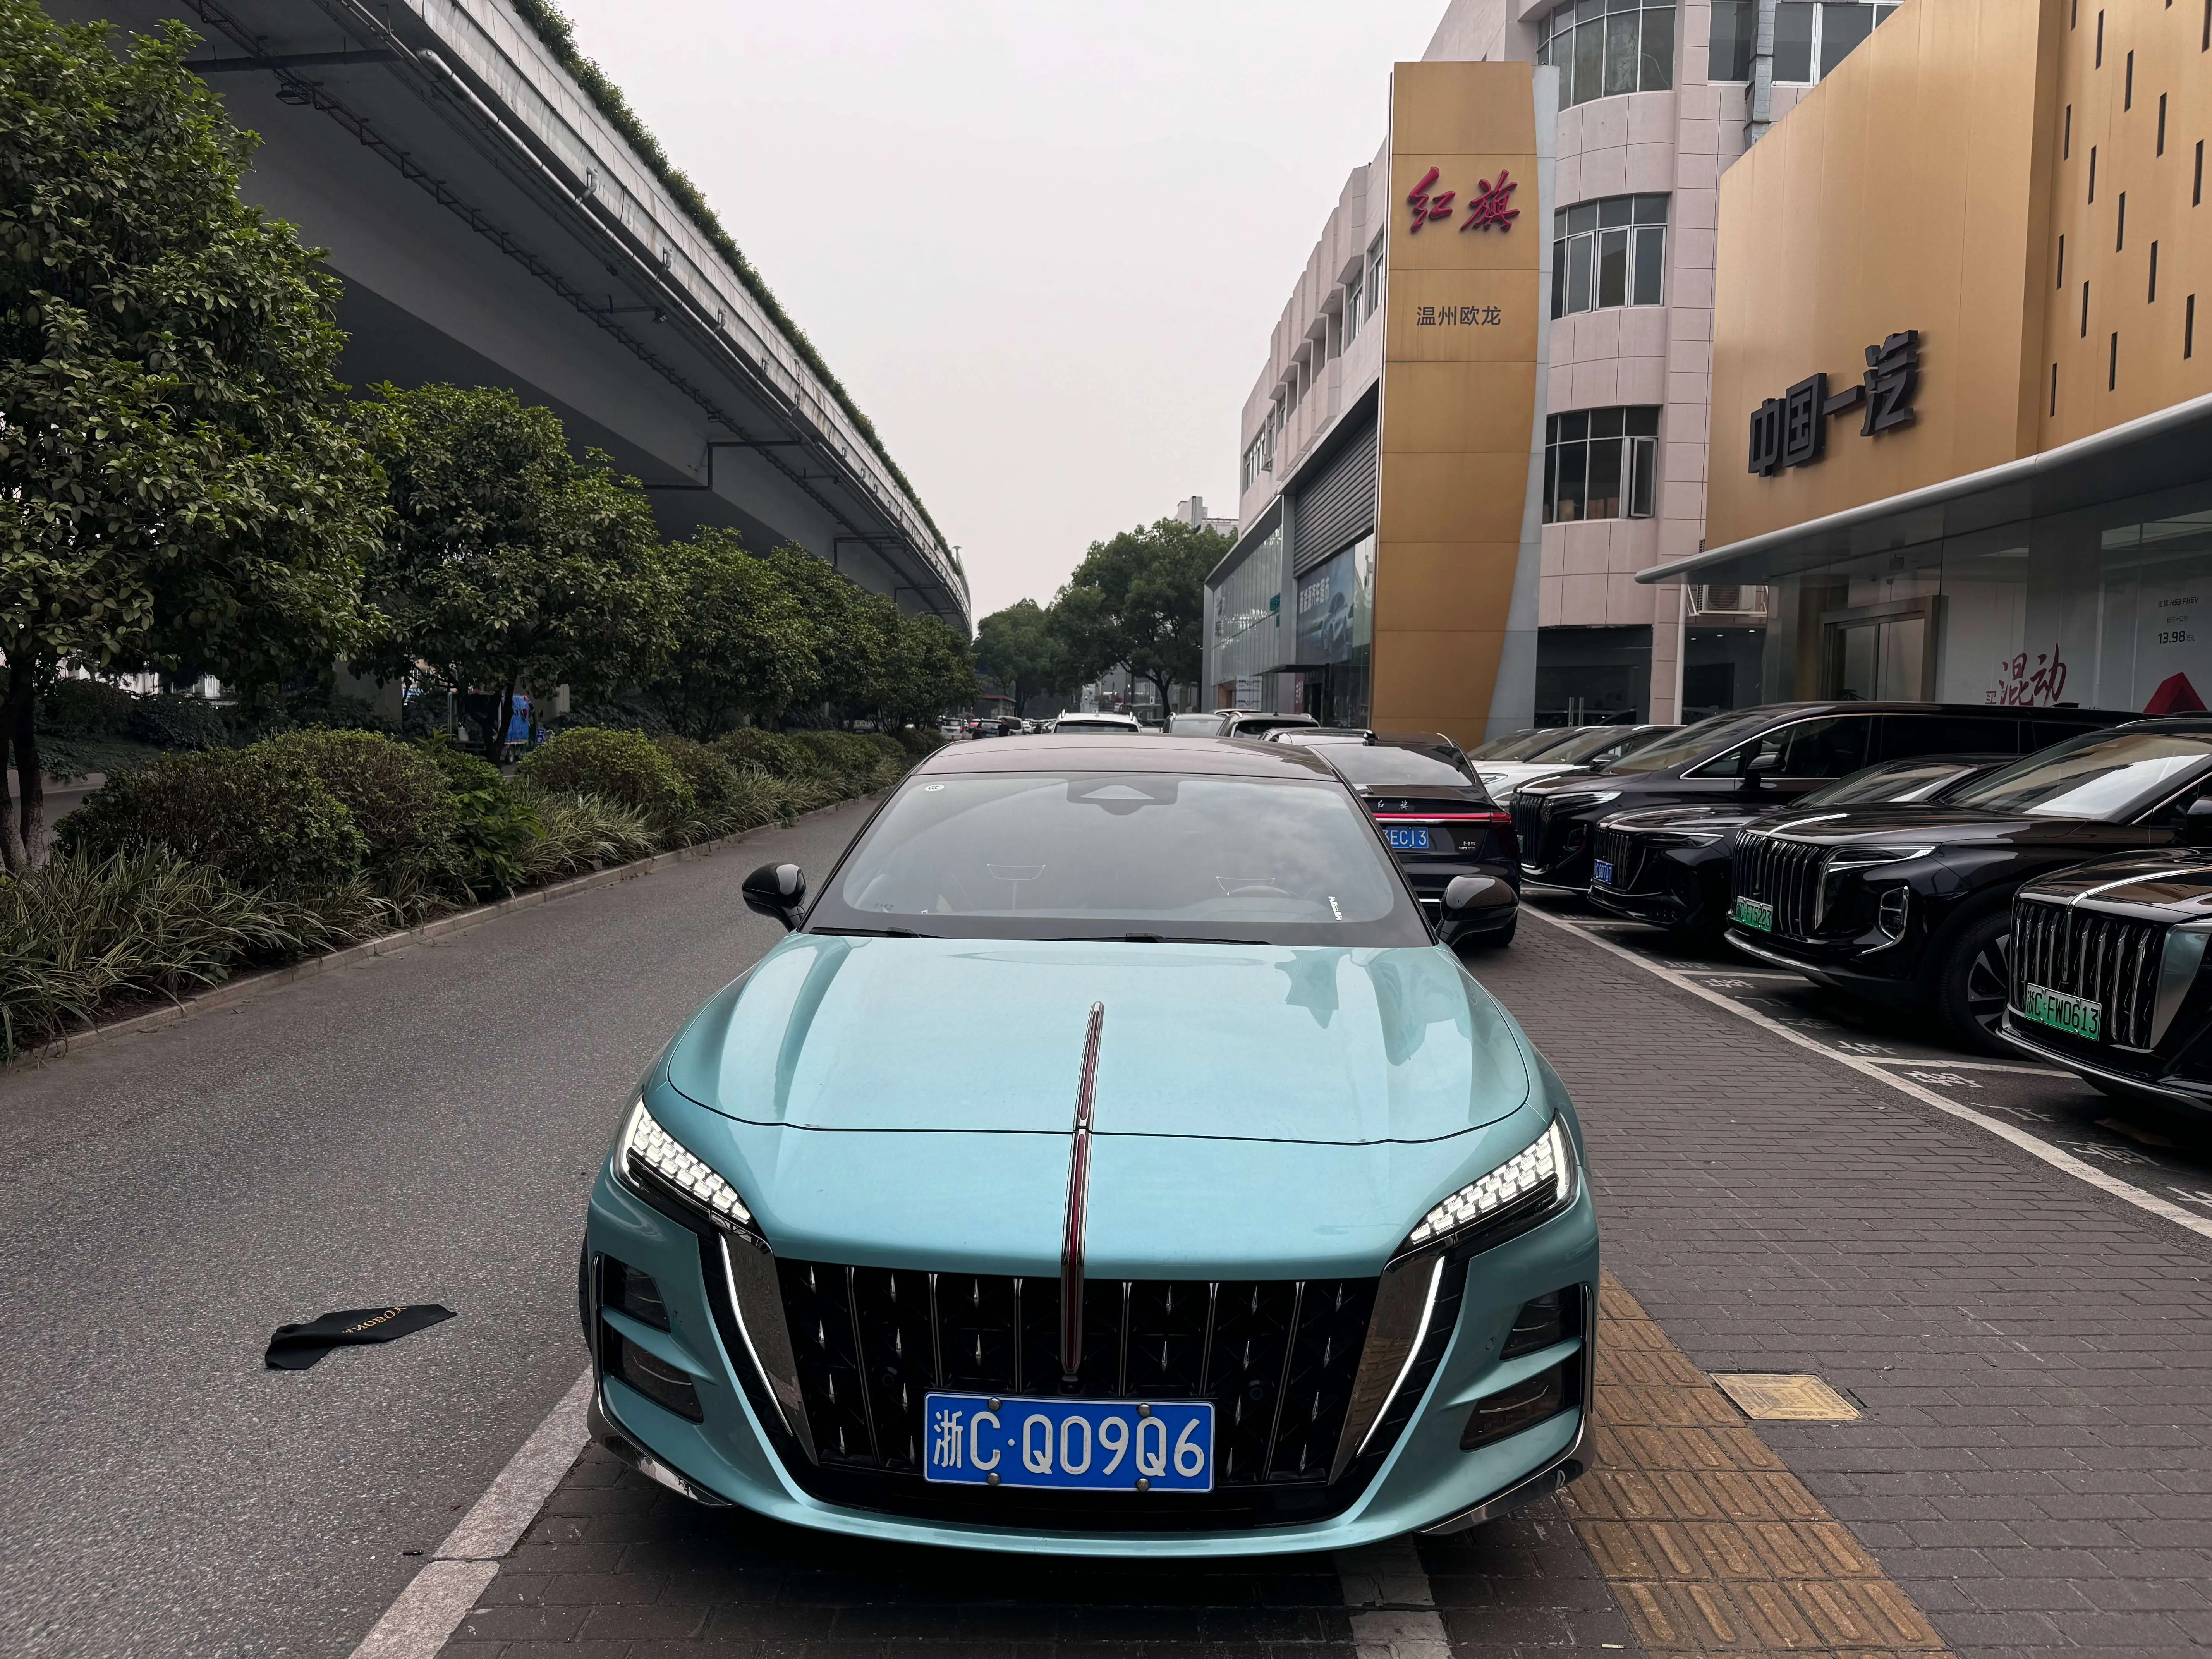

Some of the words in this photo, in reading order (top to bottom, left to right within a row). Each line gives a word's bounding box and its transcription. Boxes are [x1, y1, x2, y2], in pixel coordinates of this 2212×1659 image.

[1407, 166, 1520, 233] 红旗
[1416, 306, 1501, 326] 温州欧龙
[1748, 330, 1918, 477] 中国一汽
[1377, 800, 1408, 811] 红旗
[933, 1409, 1205, 1477] 浙C·Q09Q6
